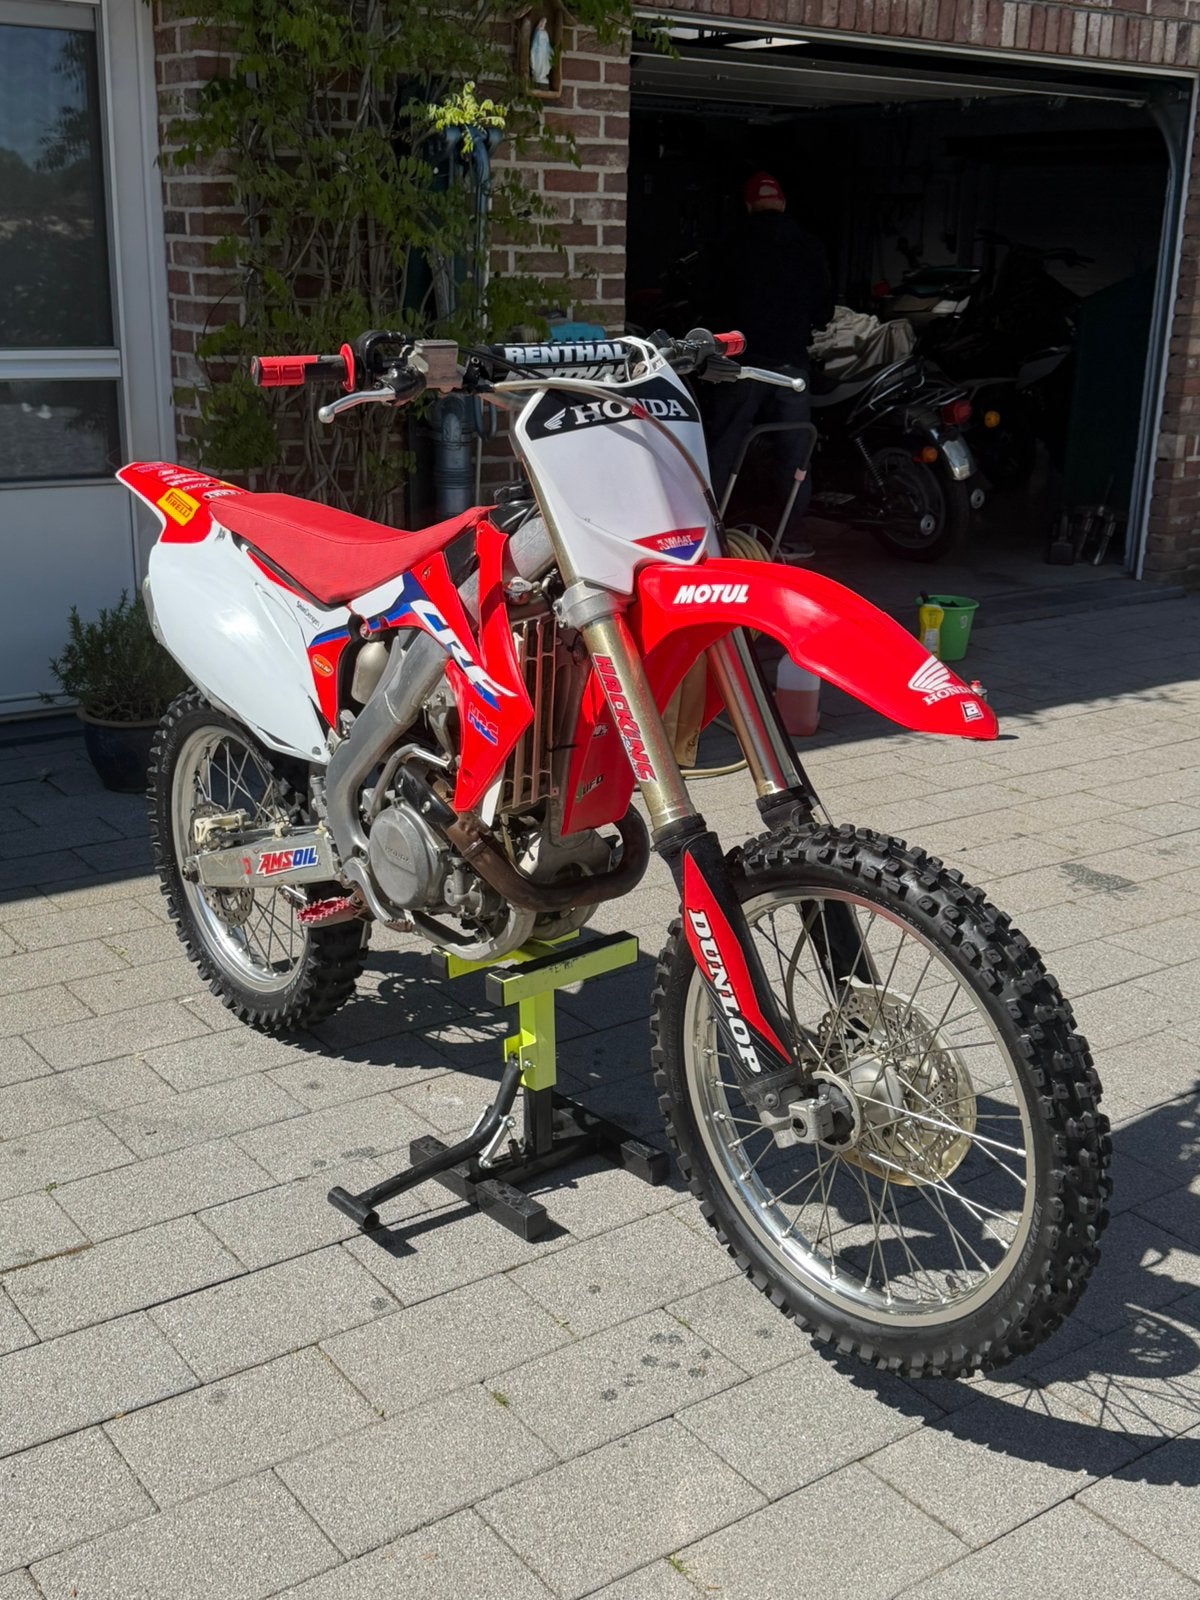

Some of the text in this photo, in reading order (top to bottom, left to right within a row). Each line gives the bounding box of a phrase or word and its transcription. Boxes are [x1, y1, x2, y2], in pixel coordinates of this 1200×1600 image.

[504, 343, 629, 364] RENTHAL
[570, 397, 690, 425] HONDA
[166, 491, 194, 519] PIRELLI
[672, 583, 750, 605] MOTUL
[593, 654, 658, 781] HACKING
[257, 846, 318, 876] AMSOIL
[686, 908, 762, 1074] DUNLOP
